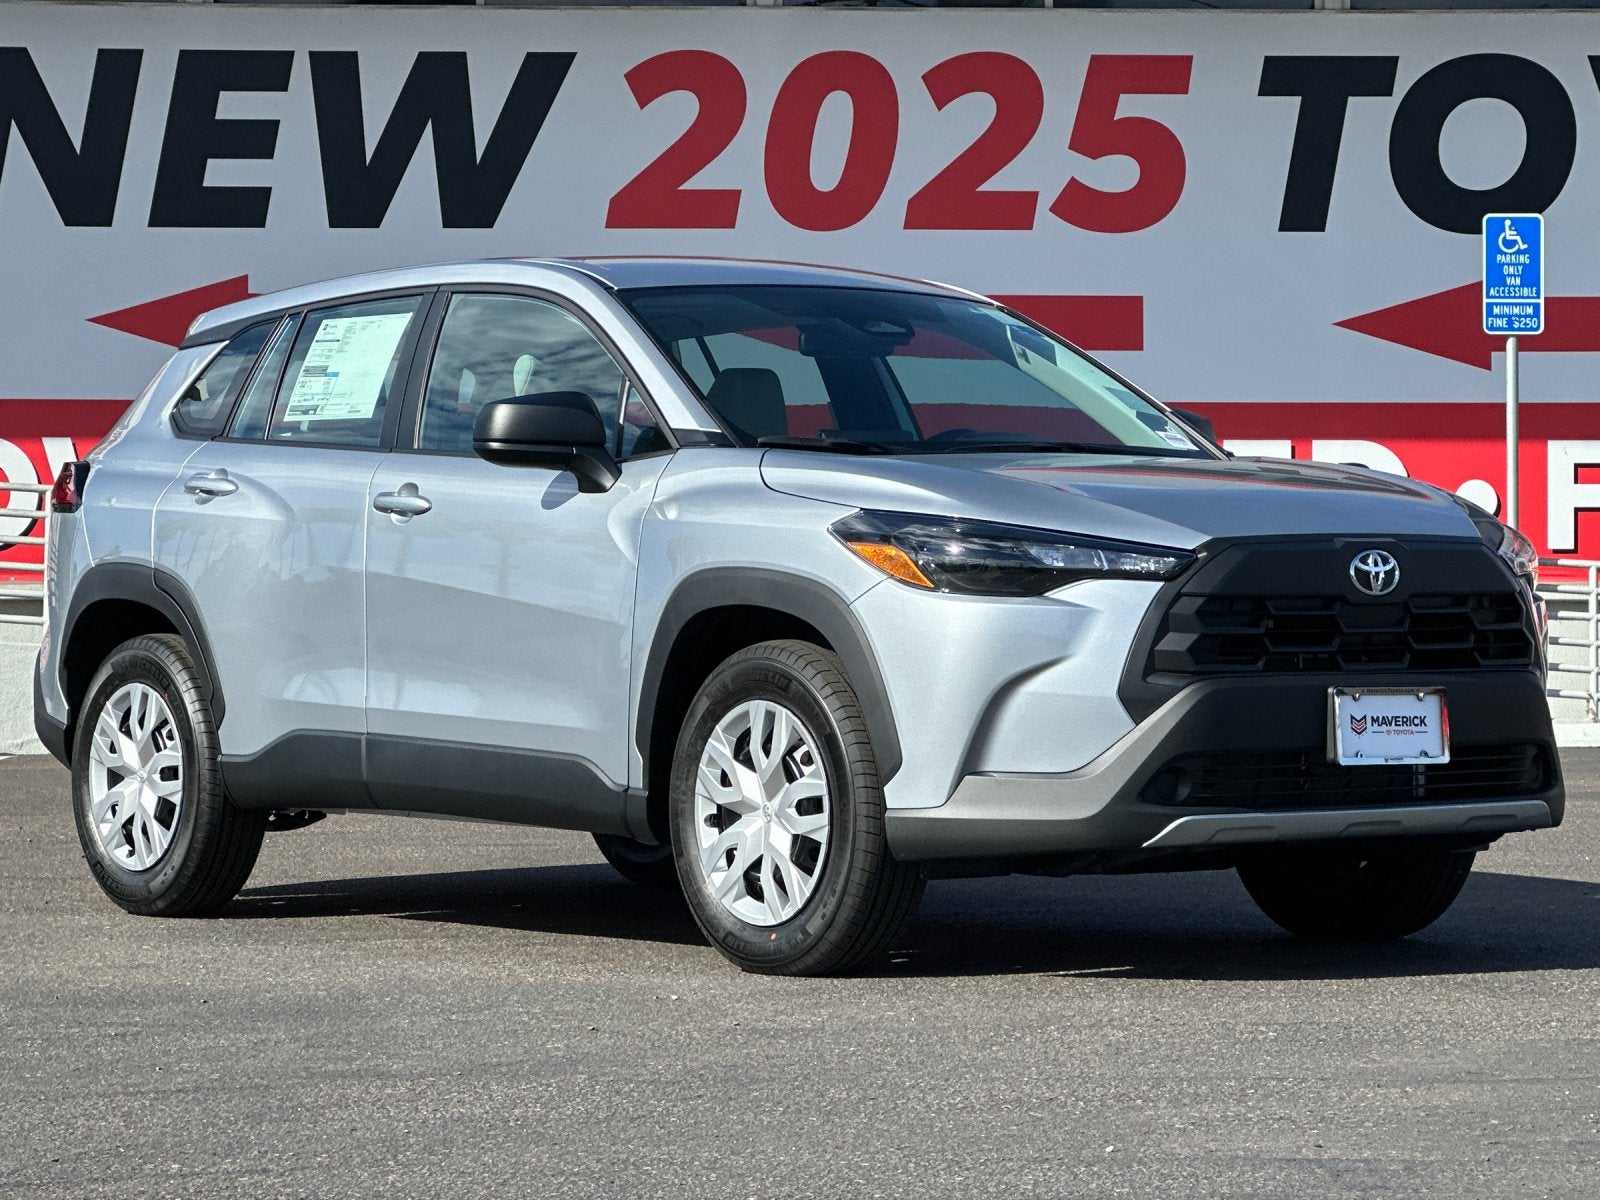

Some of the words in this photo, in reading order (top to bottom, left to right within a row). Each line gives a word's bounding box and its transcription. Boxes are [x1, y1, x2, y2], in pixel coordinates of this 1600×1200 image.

[0, 47, 578, 229] NEW
[604, 48, 1194, 234] 2025
[1257, 52, 1600, 235] TO
[1496, 254, 1530, 264] PARKING
[1503, 265, 1523, 275] ONLY
[1505, 276, 1521, 286] VAN
[1489, 287, 1537, 297] ACCESSIBLE
[1492, 305, 1533, 315] MINIMUM
[1488, 317, 1508, 328] FINE
[1511, 316, 1538, 328] $250
[1370, 715, 1428, 727] MAVERICK
